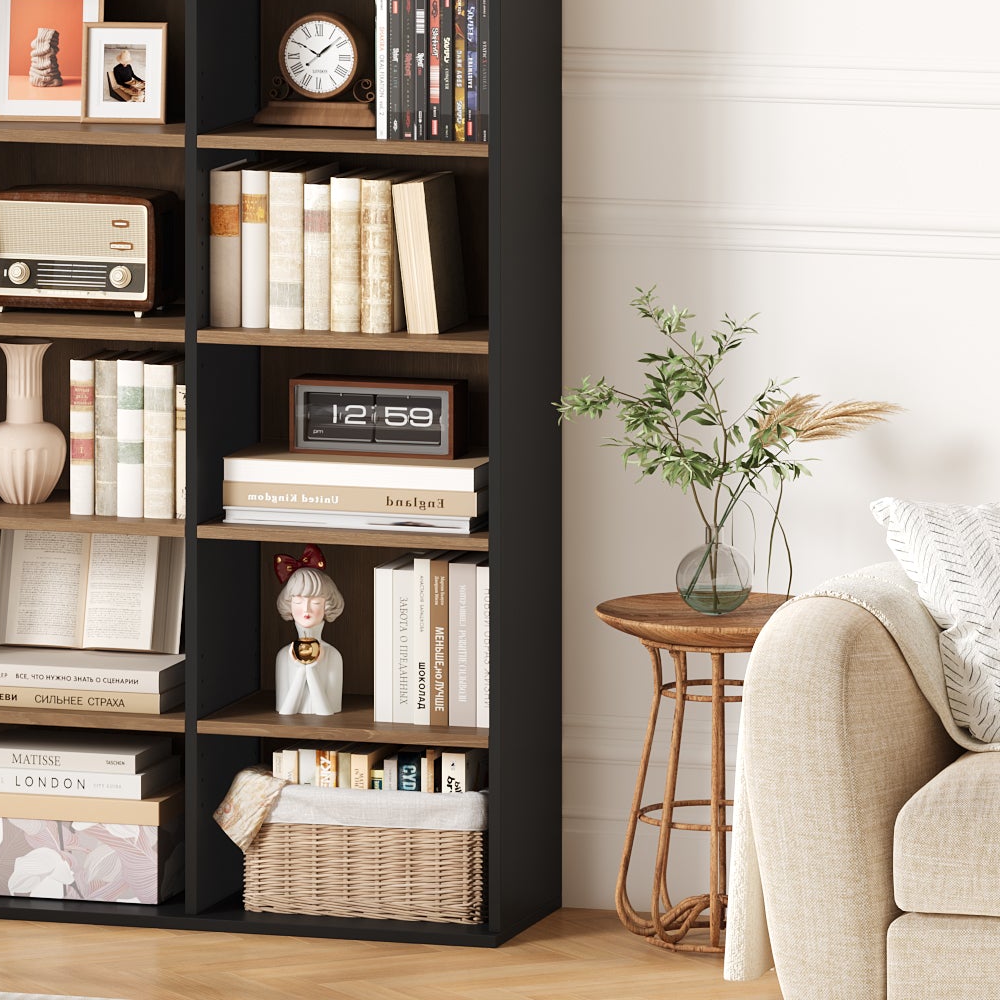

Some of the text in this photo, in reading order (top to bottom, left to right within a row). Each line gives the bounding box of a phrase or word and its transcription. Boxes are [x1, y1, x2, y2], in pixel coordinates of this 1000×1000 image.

[332, 404, 433, 427] 12 59
[312, 428, 324, 436] pm
[399, 597, 408, 632] ЗАБОТА
[15, 673, 29, 682] ВСЕ,
[31, 674, 45, 682] ЧТО
[46, 674, 72, 683] НУЖНО
[73, 675, 95, 684] ЗНАТЬ
[102, 677, 139, 686] СЦЕНАРИИ
[398, 645, 408, 705] ПРЕДАННЫХ
[417, 662, 426, 710] ШОКОЛАД
[34, 694, 125, 708] СИЛЬНЕЕ СТРАХА
[434, 680, 444, 712] ЛУЧШЕ
[11, 753, 61, 767] MATISSE
[15, 775, 86, 790] LONDON
